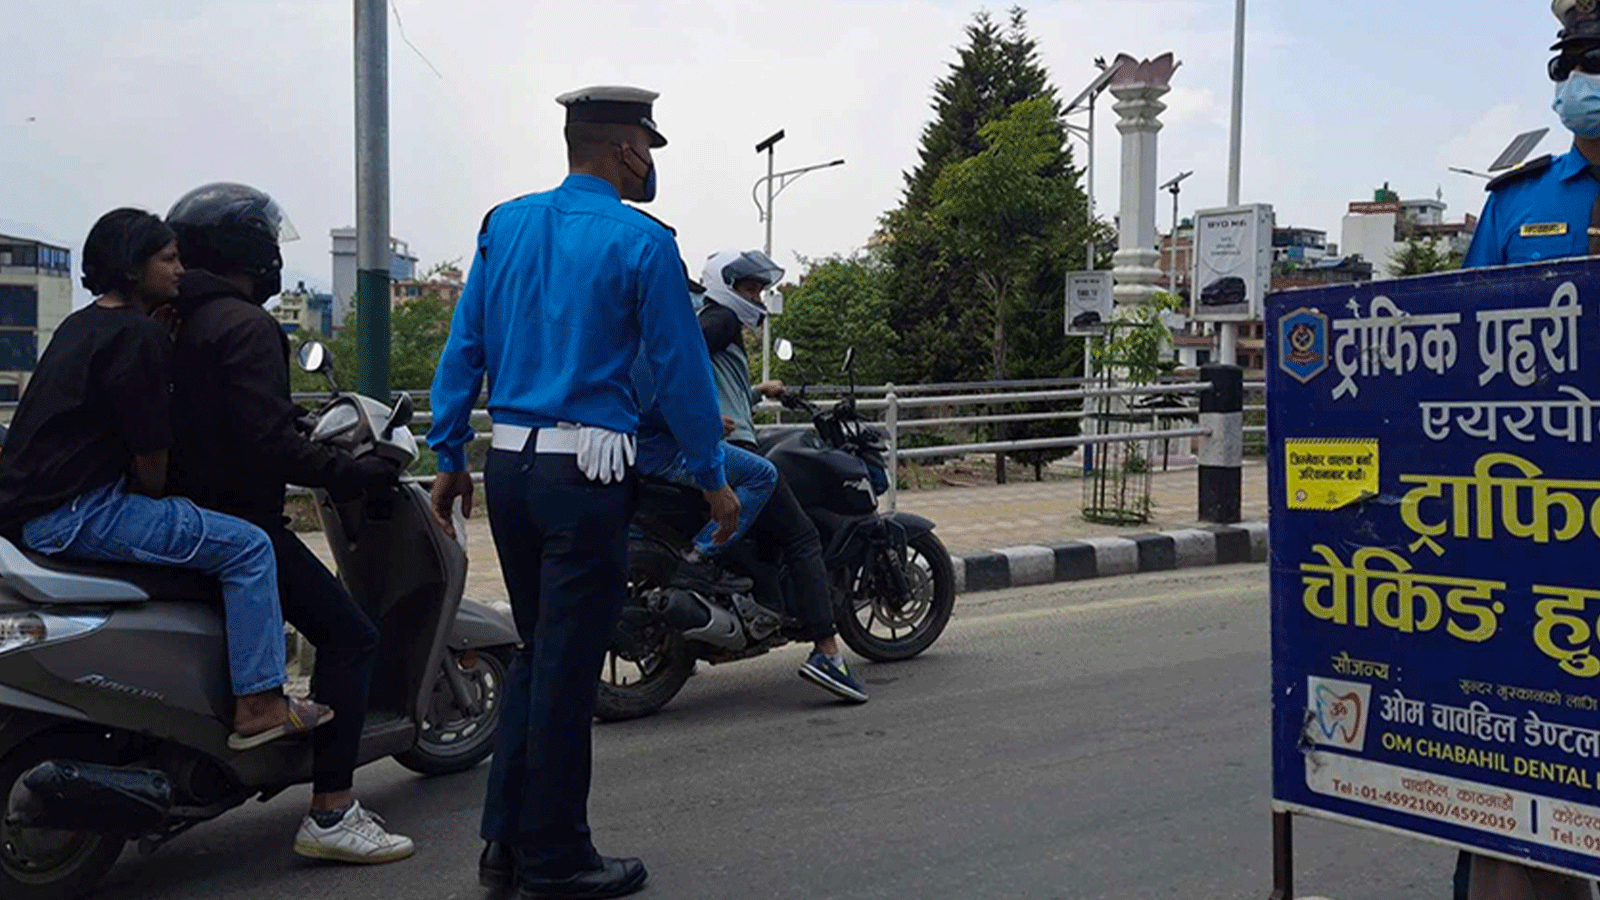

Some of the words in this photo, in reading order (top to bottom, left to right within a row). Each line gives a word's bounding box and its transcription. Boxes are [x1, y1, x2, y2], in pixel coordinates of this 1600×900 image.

[1476, 281, 1583, 387] प्रहरी
[1419, 385, 1600, 442] एयरपो
[1300, 545, 1507, 643] चेकिङ
[1532, 584, 1600, 678] हु
[1380, 689, 1425, 726] ओम
[1381, 731, 1413, 753] OM
[1416, 739, 1510, 774] CHABAHIL
[1513, 757, 1592, 790] DENTAL
